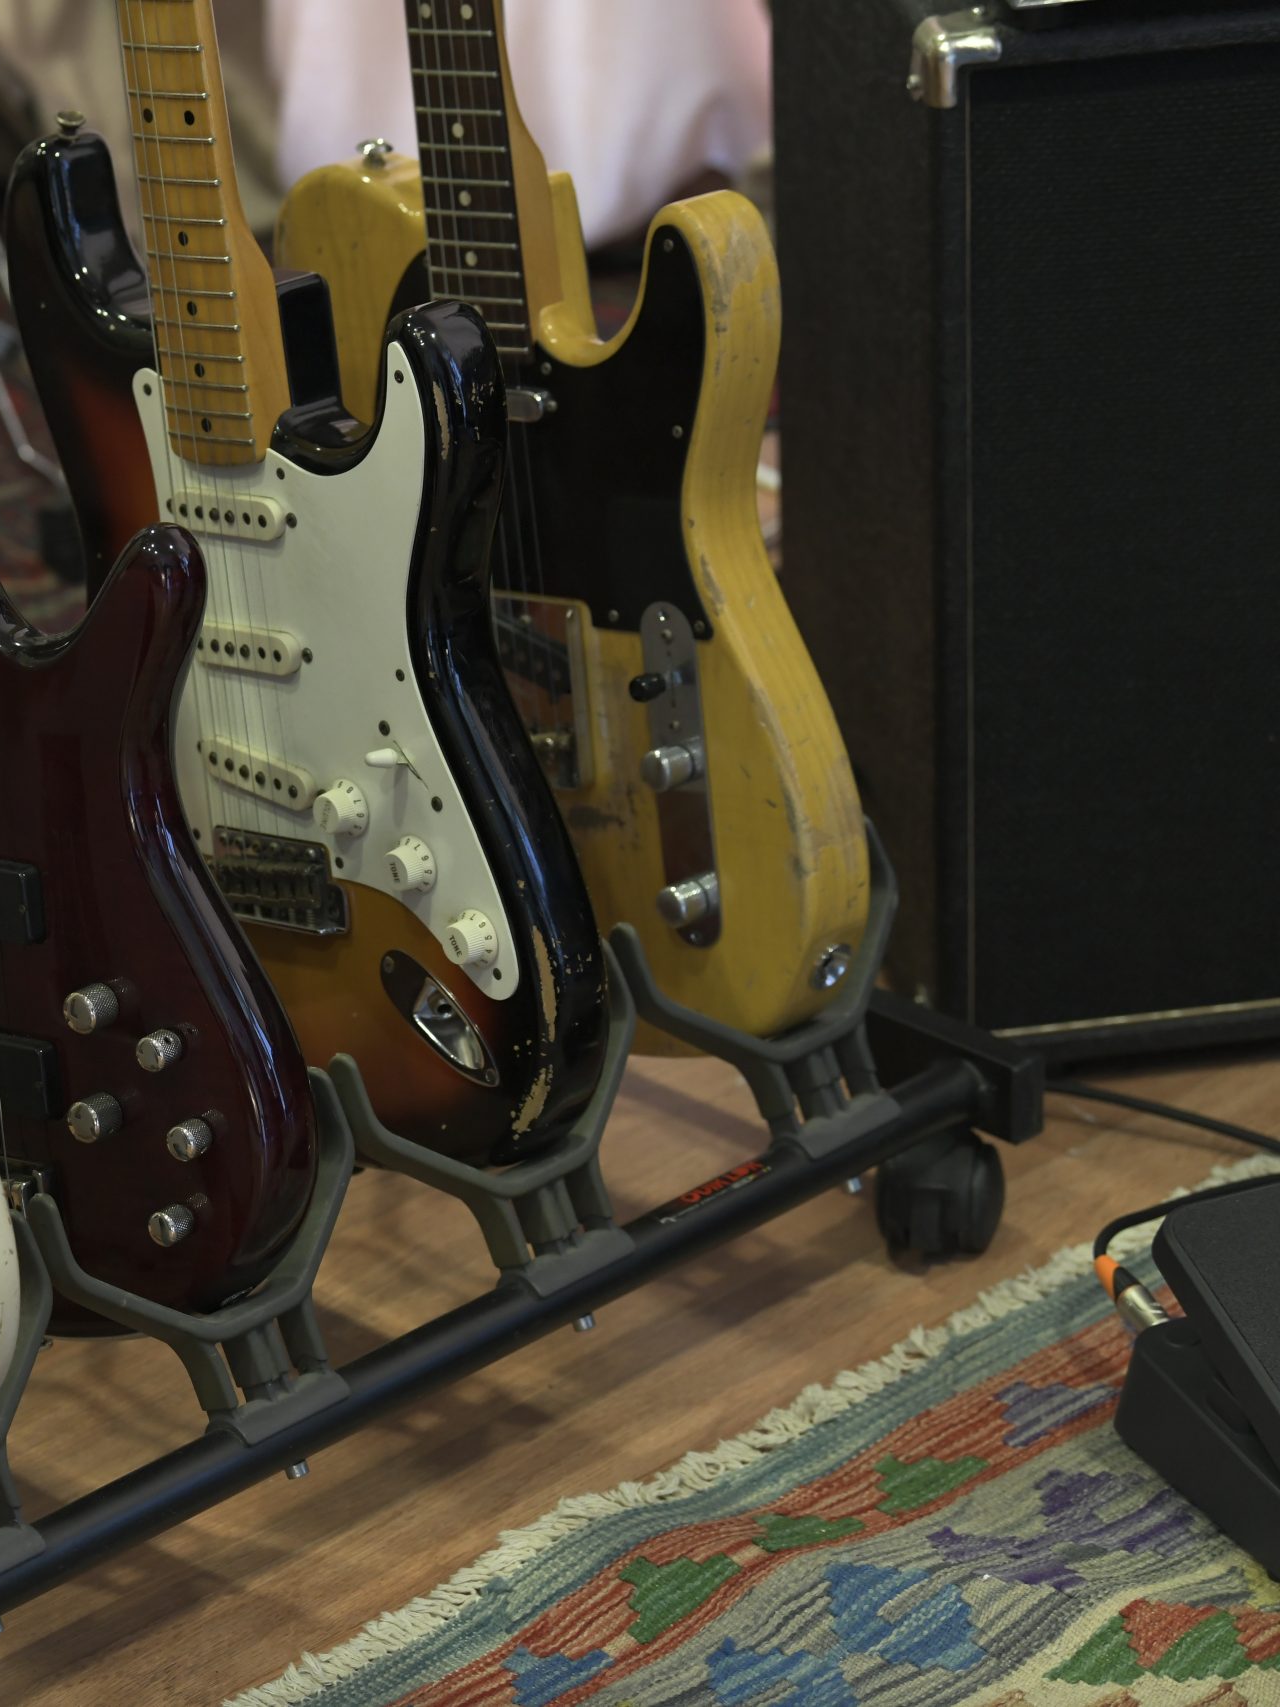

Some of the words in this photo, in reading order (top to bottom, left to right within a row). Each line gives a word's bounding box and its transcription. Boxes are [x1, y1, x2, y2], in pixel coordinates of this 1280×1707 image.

[388, 862, 401, 883] TONE
[478, 921, 487, 929] 6
[449, 934, 463, 958] TONE
